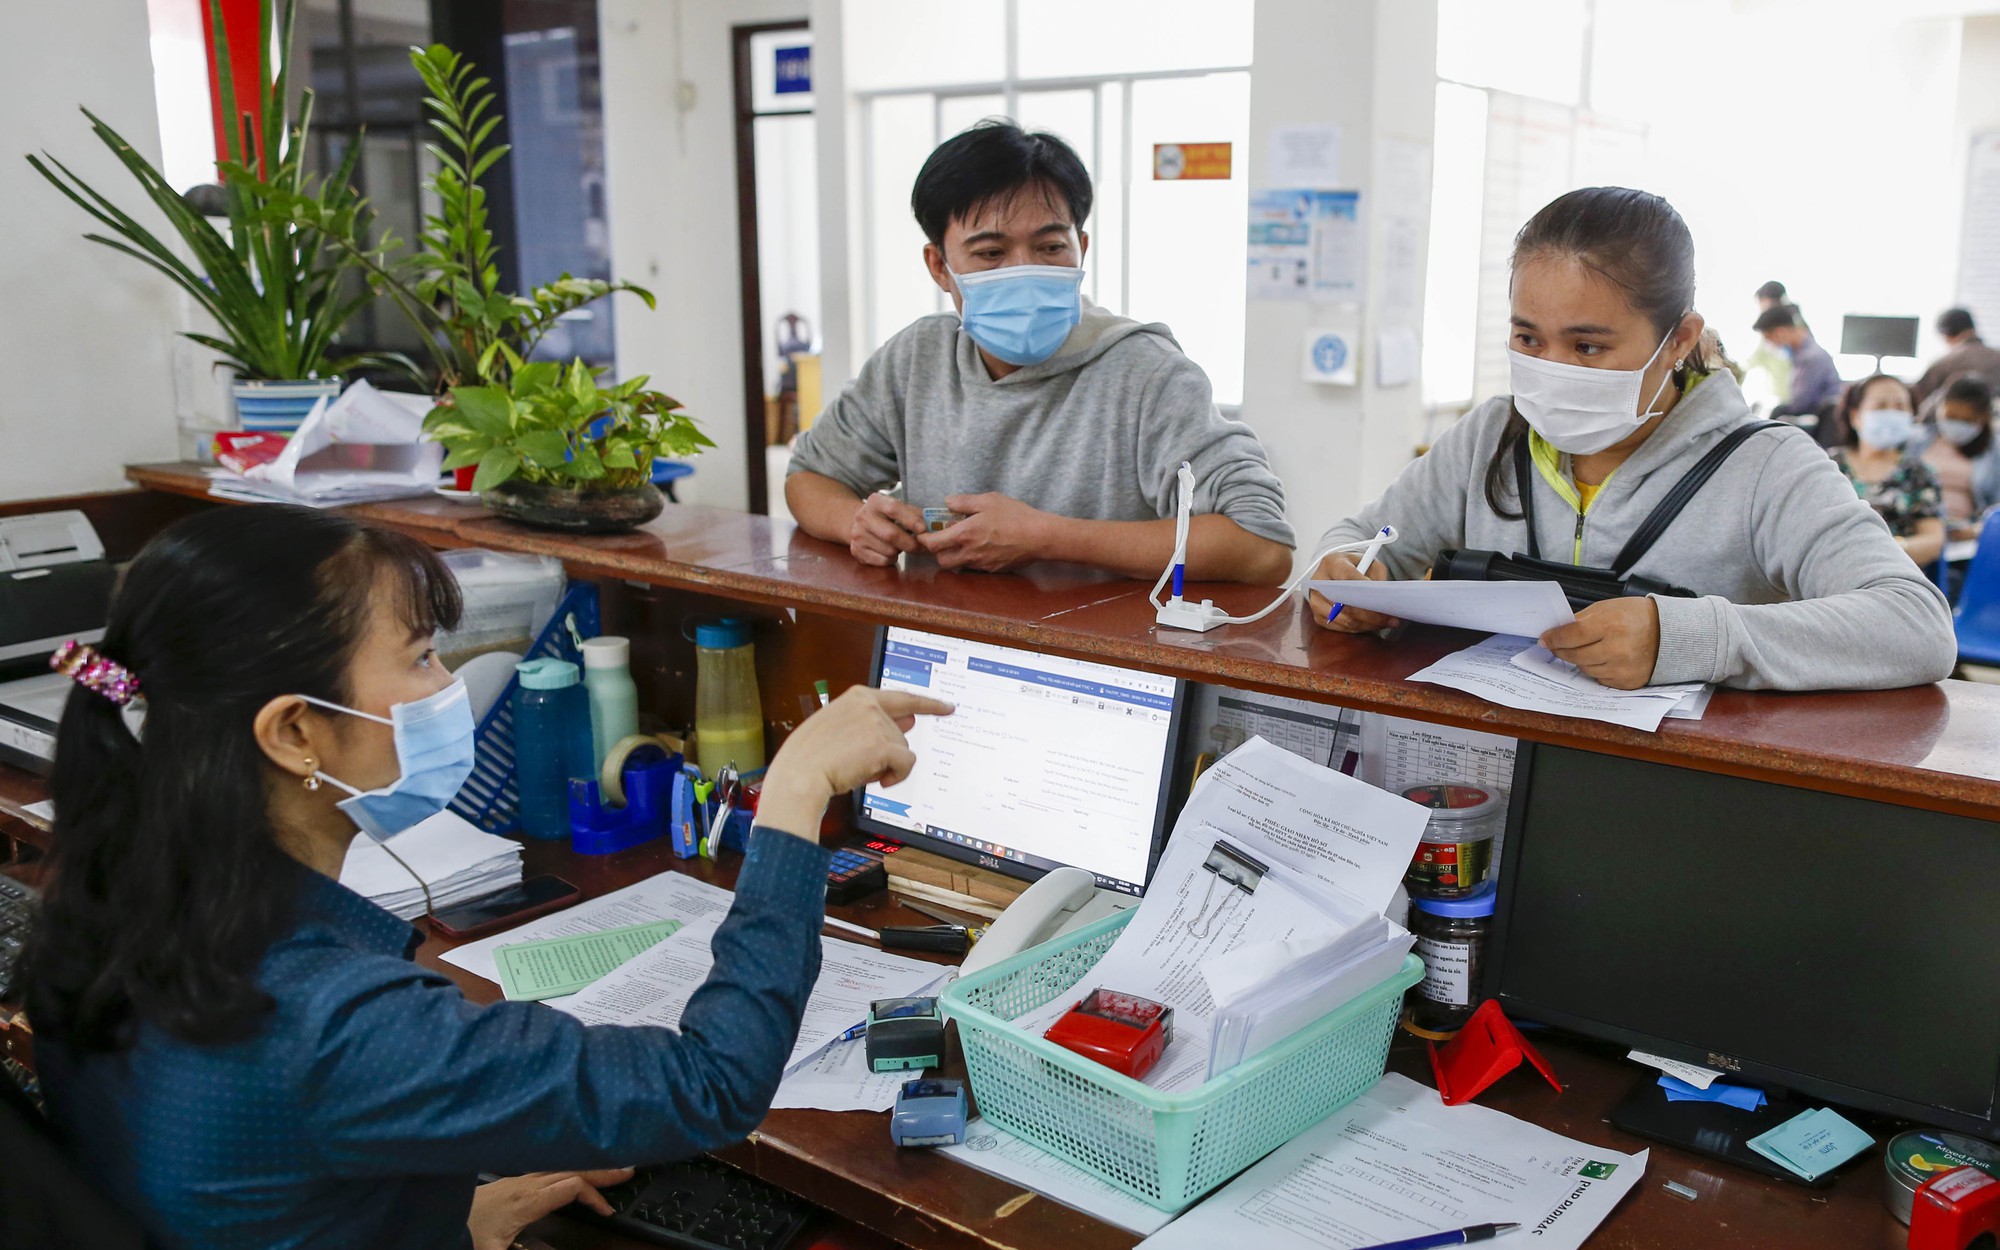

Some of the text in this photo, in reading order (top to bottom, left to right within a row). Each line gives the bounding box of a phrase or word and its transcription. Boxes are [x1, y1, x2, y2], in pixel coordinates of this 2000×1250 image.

[1707, 1052, 1740, 1071] DELL
[1936, 1145, 1991, 1169] Mixed Fruit
